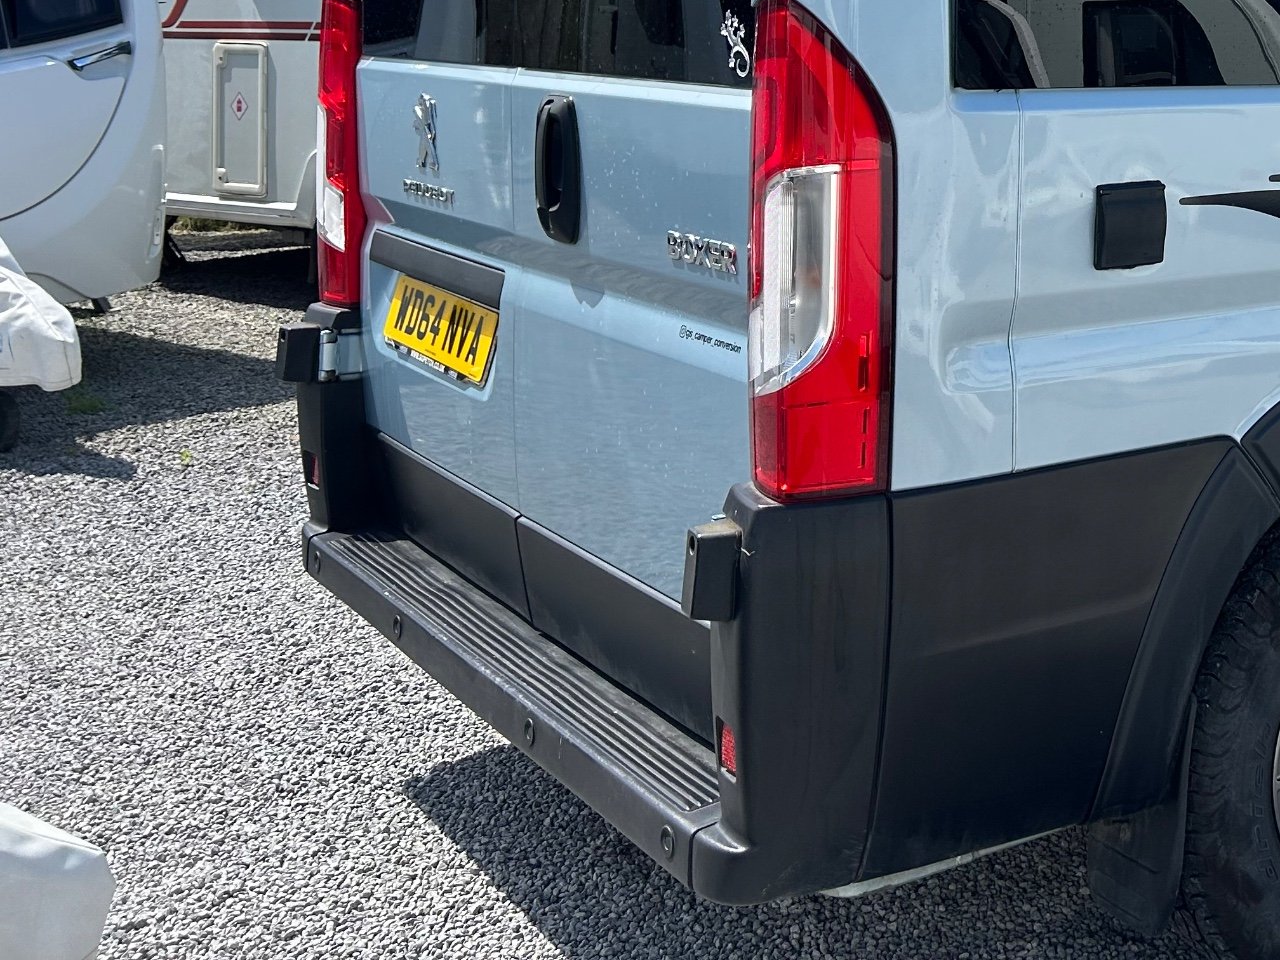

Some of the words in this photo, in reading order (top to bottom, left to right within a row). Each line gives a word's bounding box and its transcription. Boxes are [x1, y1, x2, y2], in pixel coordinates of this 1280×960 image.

[403, 179, 454, 205] PEUGEOT
[667, 230, 738, 274] BOXER
[394, 284, 447, 347] WD64
[441, 304, 484, 366] NVA
